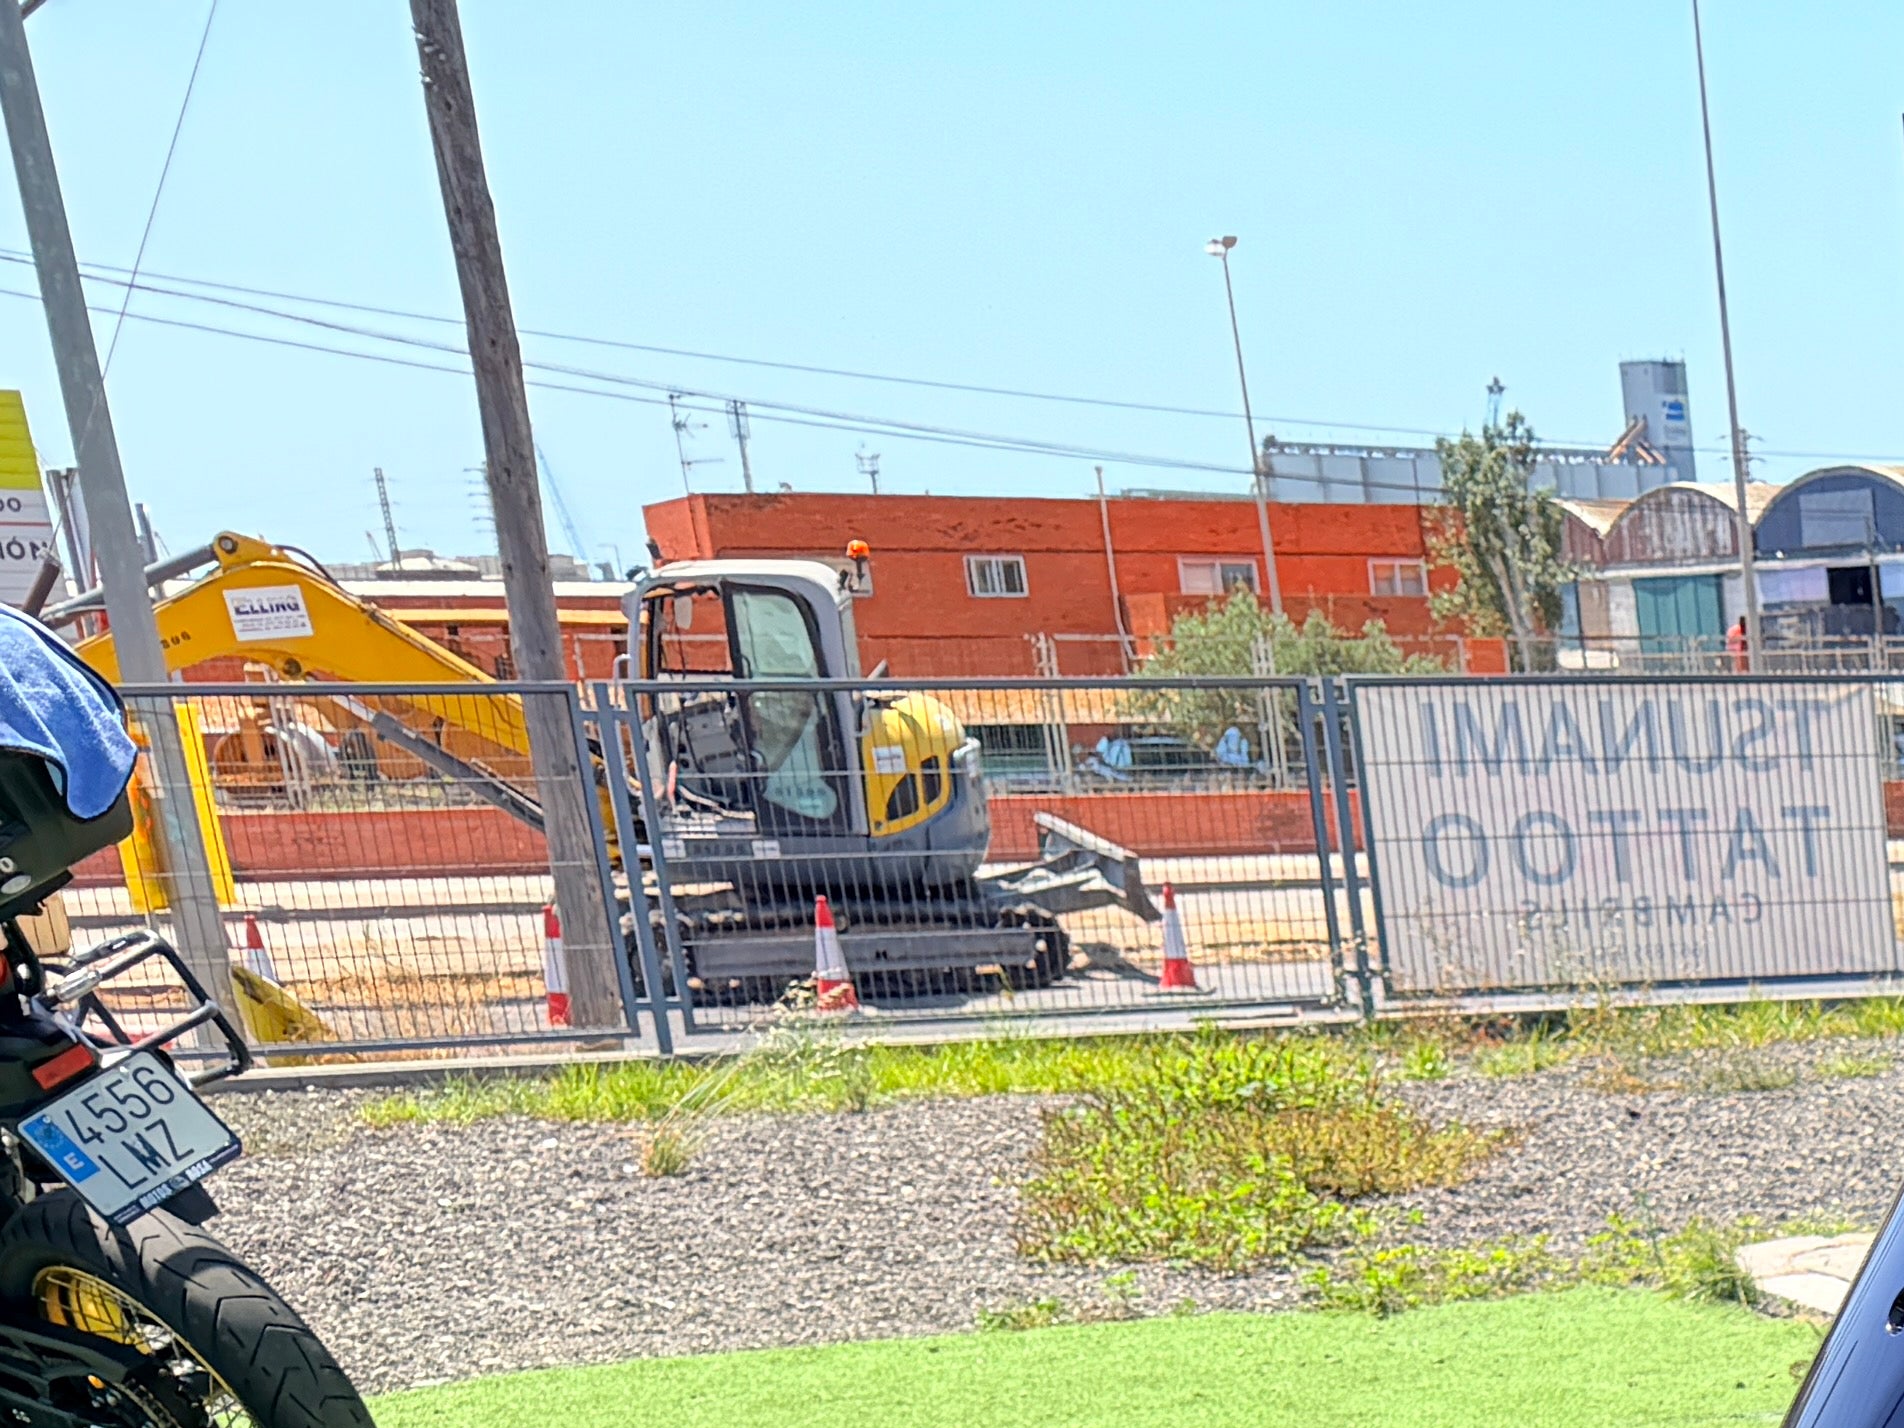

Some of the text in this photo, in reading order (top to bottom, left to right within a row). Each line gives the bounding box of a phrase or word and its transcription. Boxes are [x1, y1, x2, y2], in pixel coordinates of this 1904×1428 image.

[64, 1066, 175, 1145] 4556
[63, 1151, 86, 1170] E
[97, 1118, 196, 1191] LMZ
